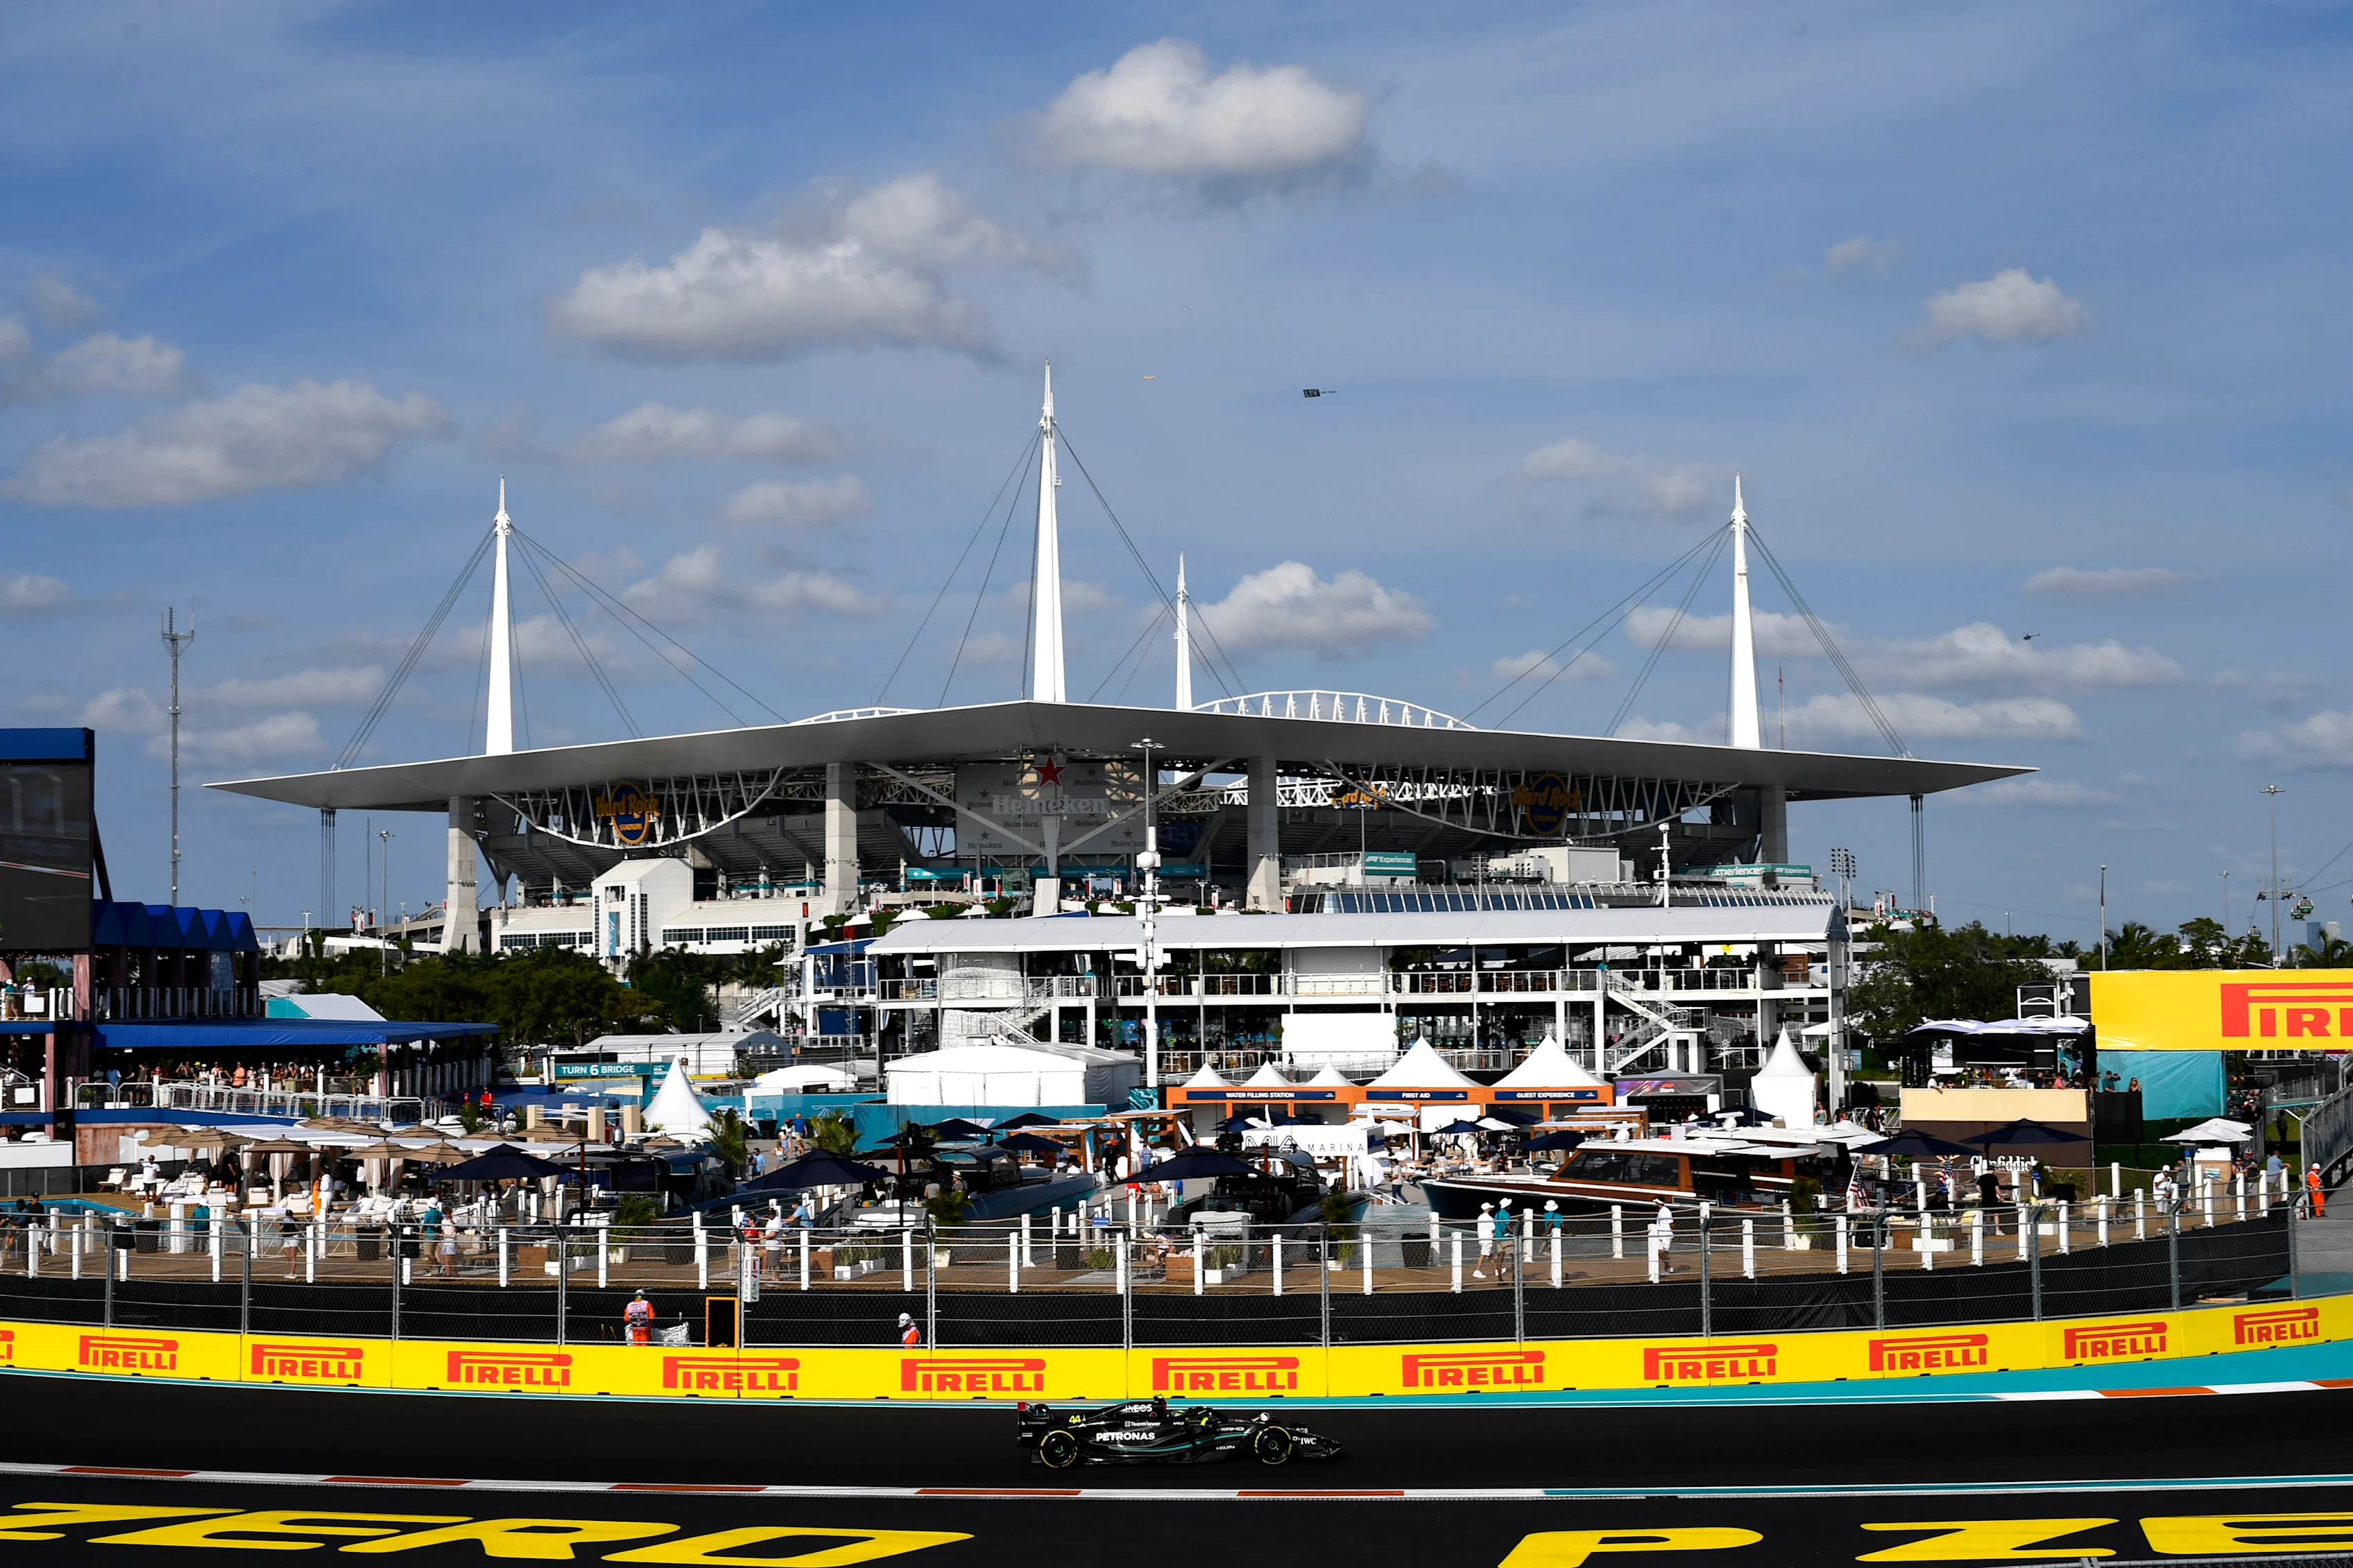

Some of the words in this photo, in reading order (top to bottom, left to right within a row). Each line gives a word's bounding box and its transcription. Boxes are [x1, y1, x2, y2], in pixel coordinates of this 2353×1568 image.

[595, 794, 627, 817] Hard
[628, 792, 660, 818] Rock
[993, 795, 1109, 815] Heineken
[1512, 784, 1549, 806] Hard
[1549, 786, 1582, 811] Rock
[2221, 983, 2353, 1037] PIR
[562, 1066, 587, 1075] TURN
[590, 1065, 599, 1076] 6
[601, 1065, 635, 1074] BRIDGE
[1308, 1144, 1364, 1152] MARINA
[2064, 1322, 2167, 1359] PIRELLI
[2234, 1308, 2318, 1344] PIRELLI
[80, 1336, 178, 1370] PIRELLI
[252, 1344, 363, 1379] PIRELLI
[447, 1351, 572, 1386] PIRELLI
[1403, 1351, 1545, 1386] PIRELLI
[1644, 1344, 1777, 1379] PIRELLI
[1869, 1334, 1987, 1371] PIRELLI
[663, 1356, 799, 1390] PIRELLI
[902, 1359, 1045, 1391] PIRELLI
[1153, 1357, 1299, 1390] PIRELLI
[1068, 1415, 1082, 1424] 44
[1124, 1404, 1153, 1413] INEOS
[1096, 1431, 1156, 1442] PETRONAS
